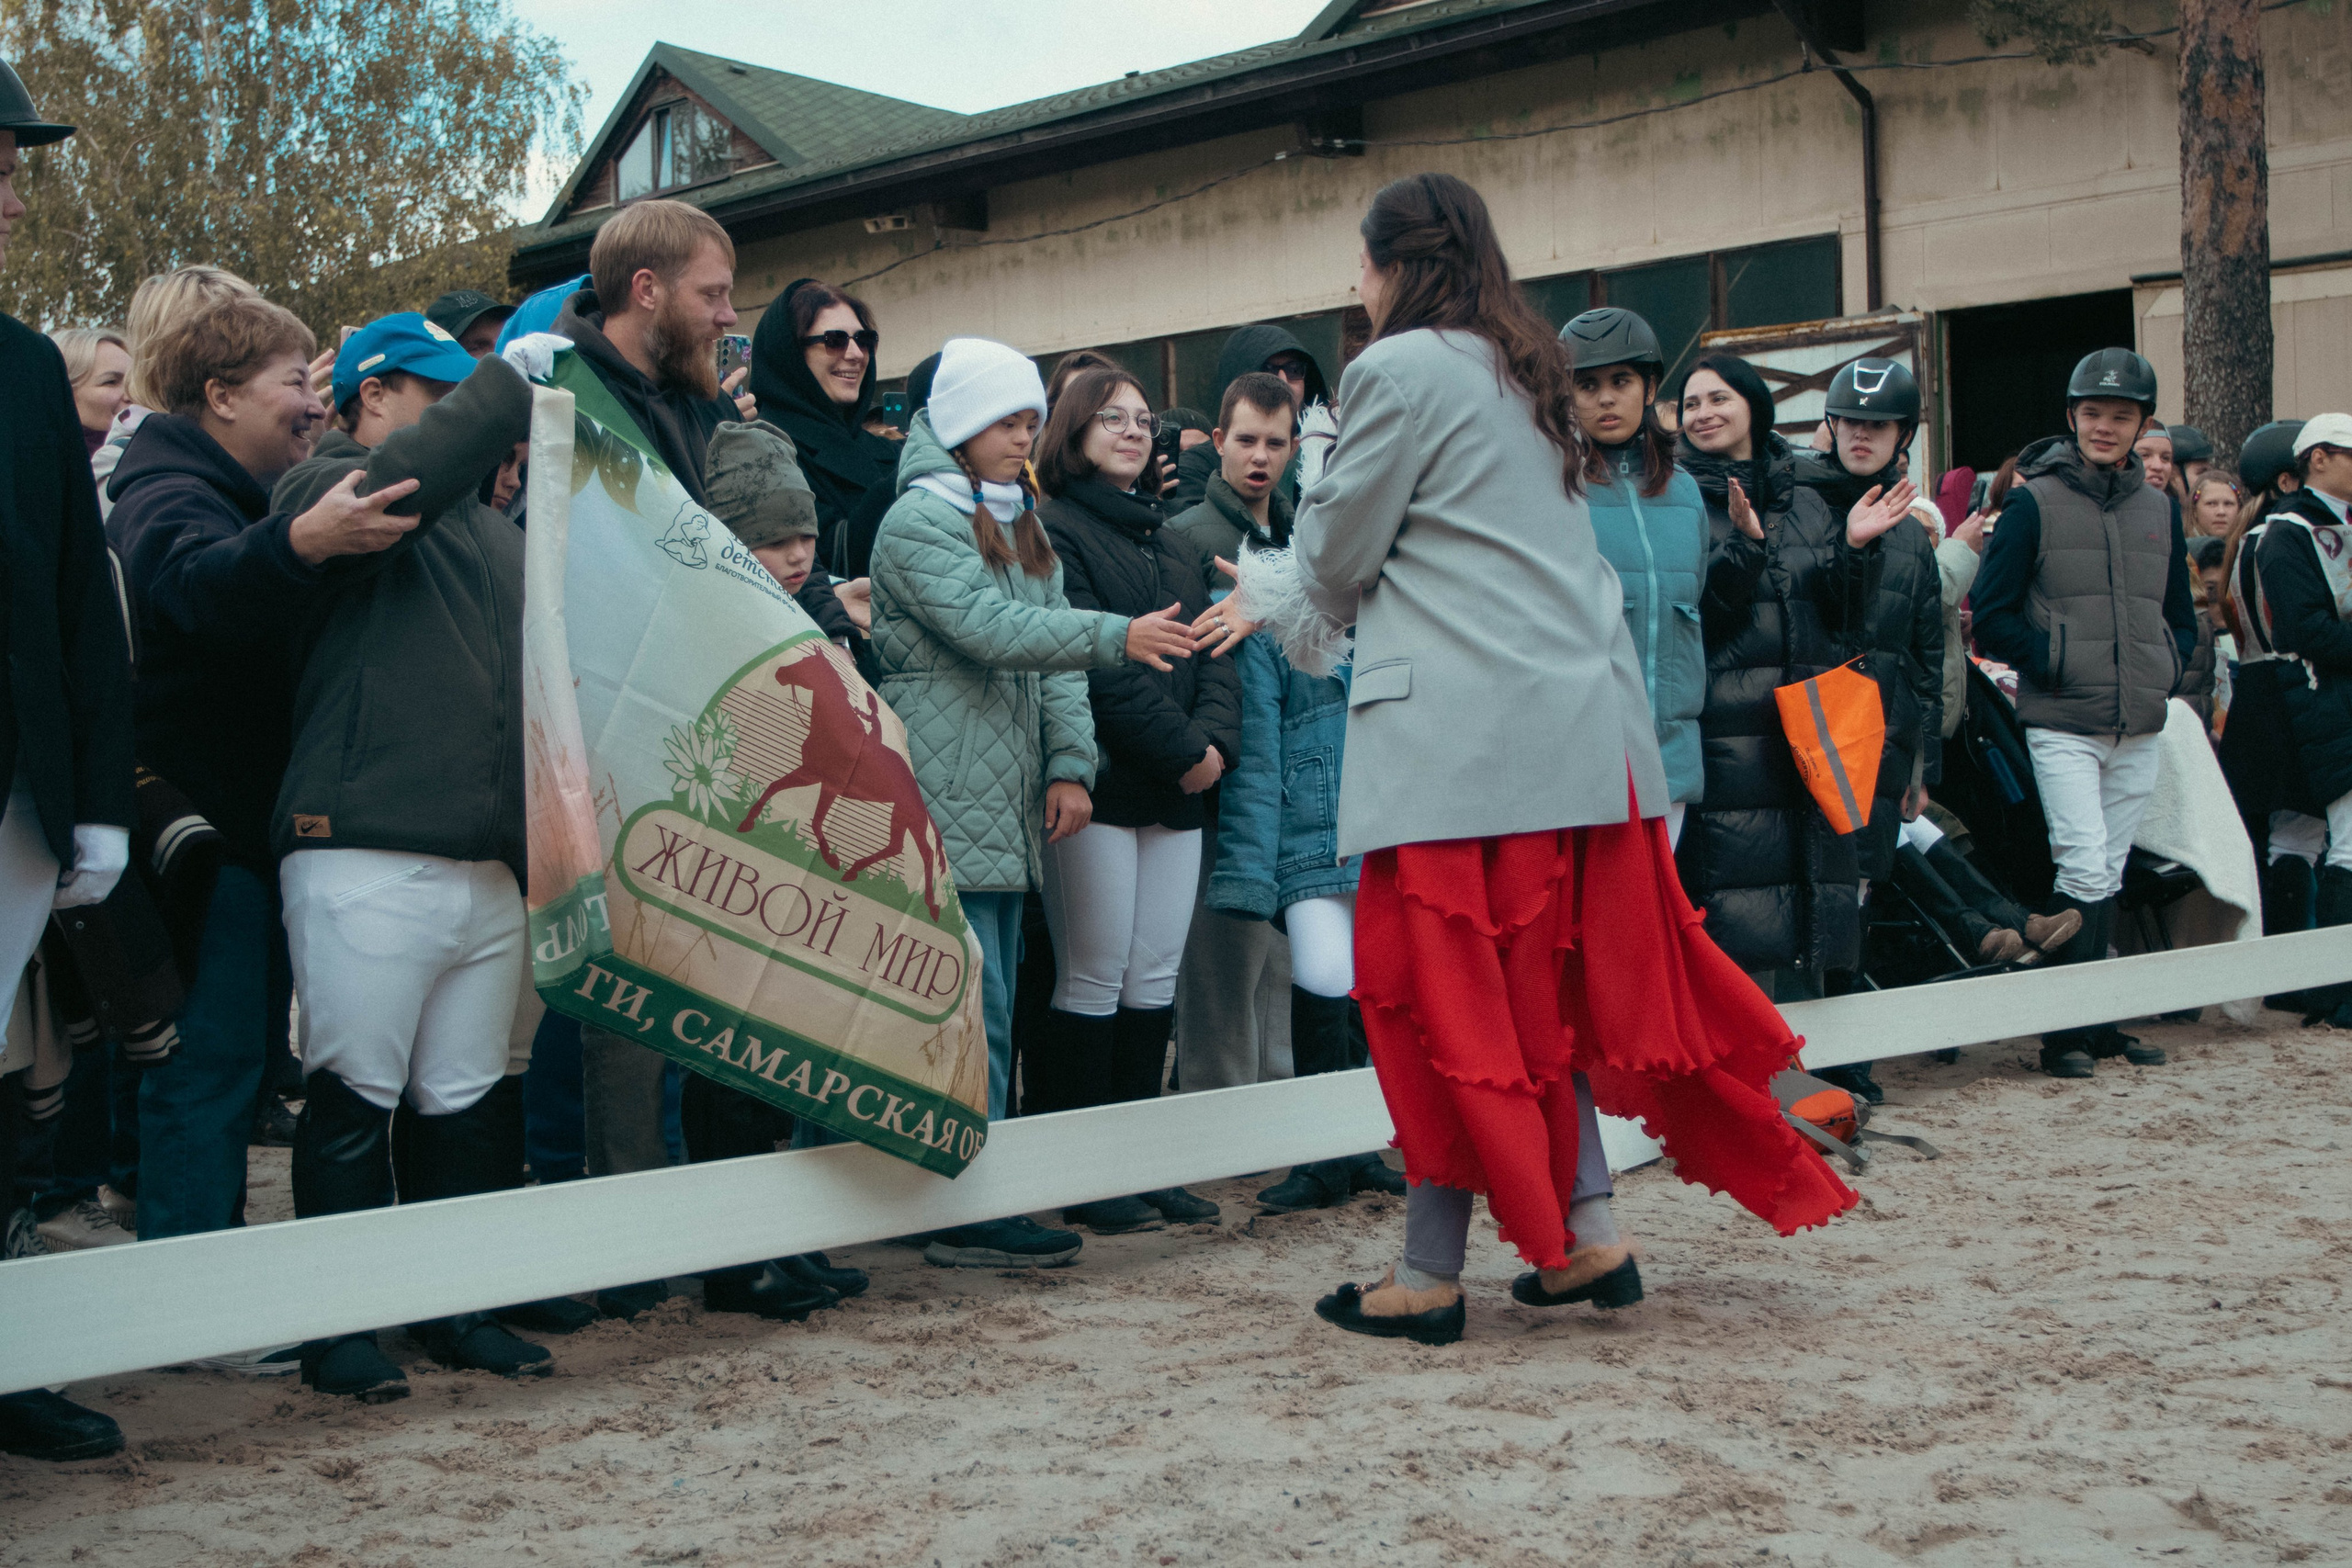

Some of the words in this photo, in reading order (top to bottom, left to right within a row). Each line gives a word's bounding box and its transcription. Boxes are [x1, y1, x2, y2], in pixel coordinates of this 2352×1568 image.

[715, 562, 782, 603] БЛАГОТВОРИТЕЛЬНЫЙ
[632, 823, 851, 957] ЖИВОЙ
[858, 921, 961, 1000] МИР
[672, 1009, 959, 1155] САМАРСКАЯ
